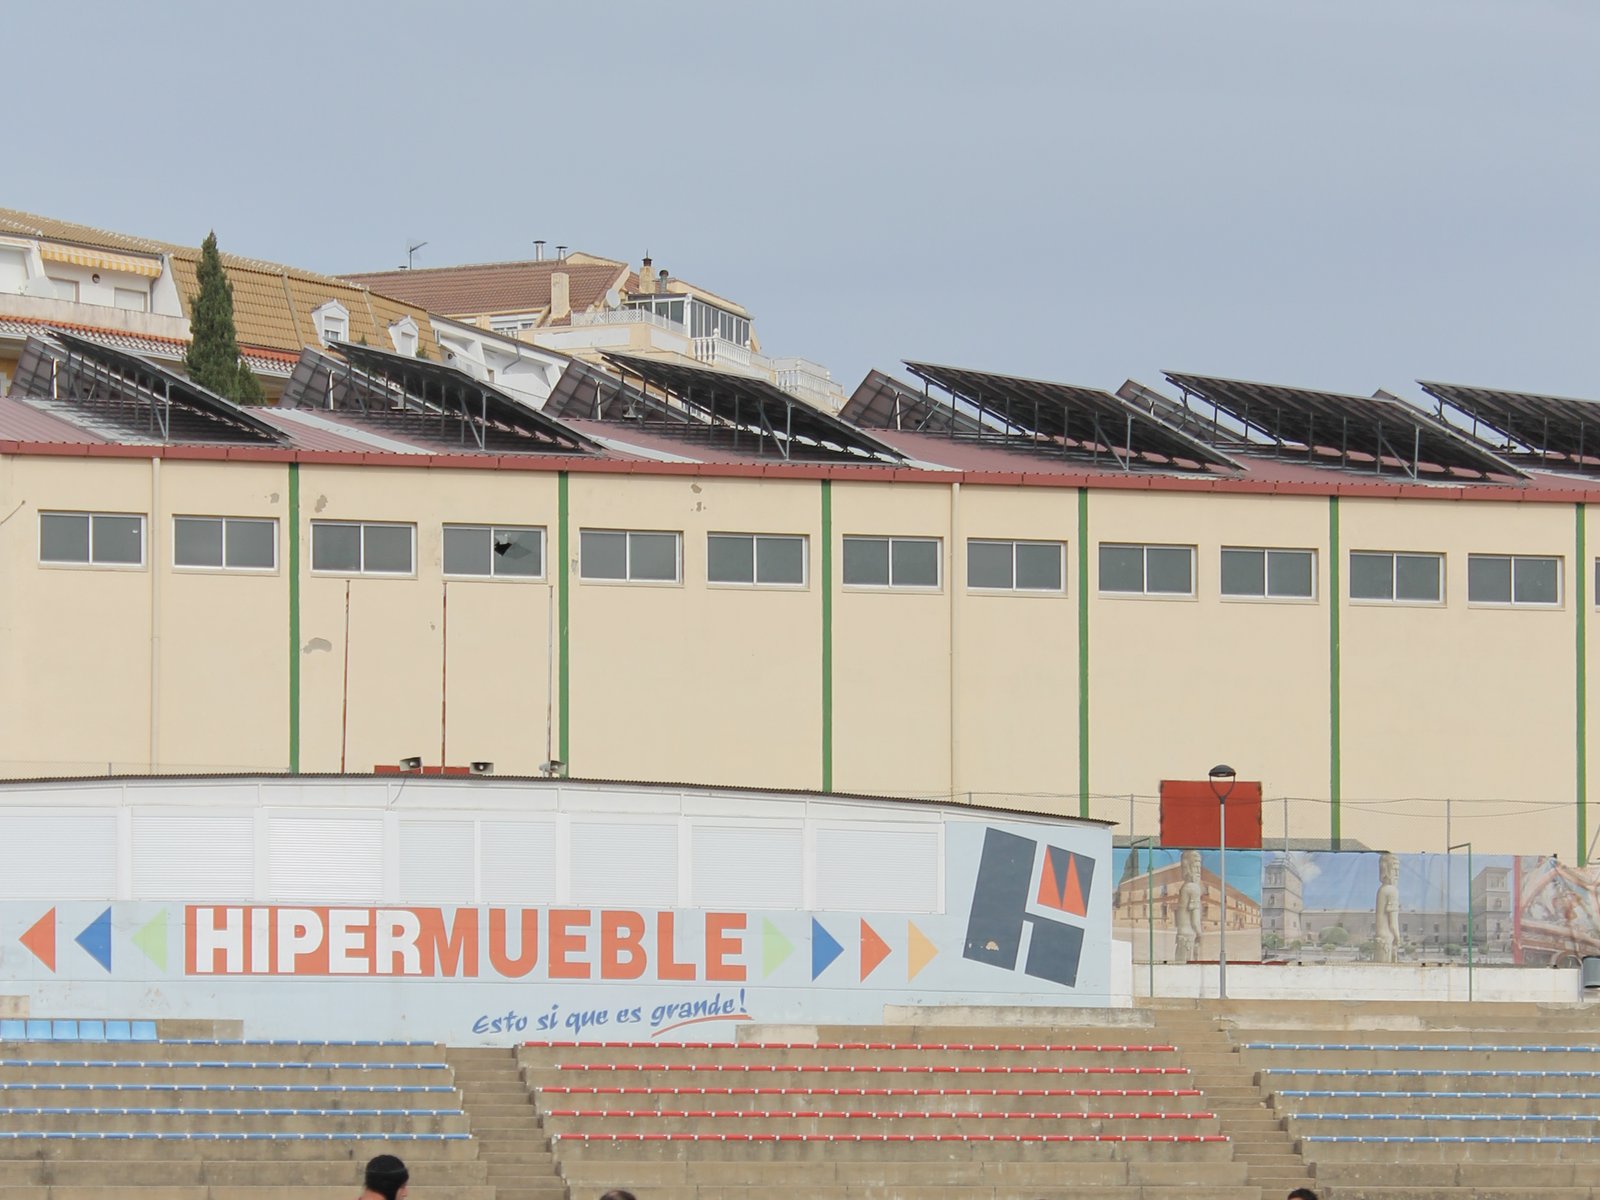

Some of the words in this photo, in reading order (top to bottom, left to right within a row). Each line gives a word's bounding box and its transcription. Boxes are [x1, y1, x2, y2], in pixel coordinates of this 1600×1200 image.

[195, 906, 748, 982] HIPERMUEBLE
[472, 1010, 528, 1035] Esto
[564, 1009, 609, 1036] que
[616, 1006, 642, 1025] es
[650, 987, 748, 1028] grande!
